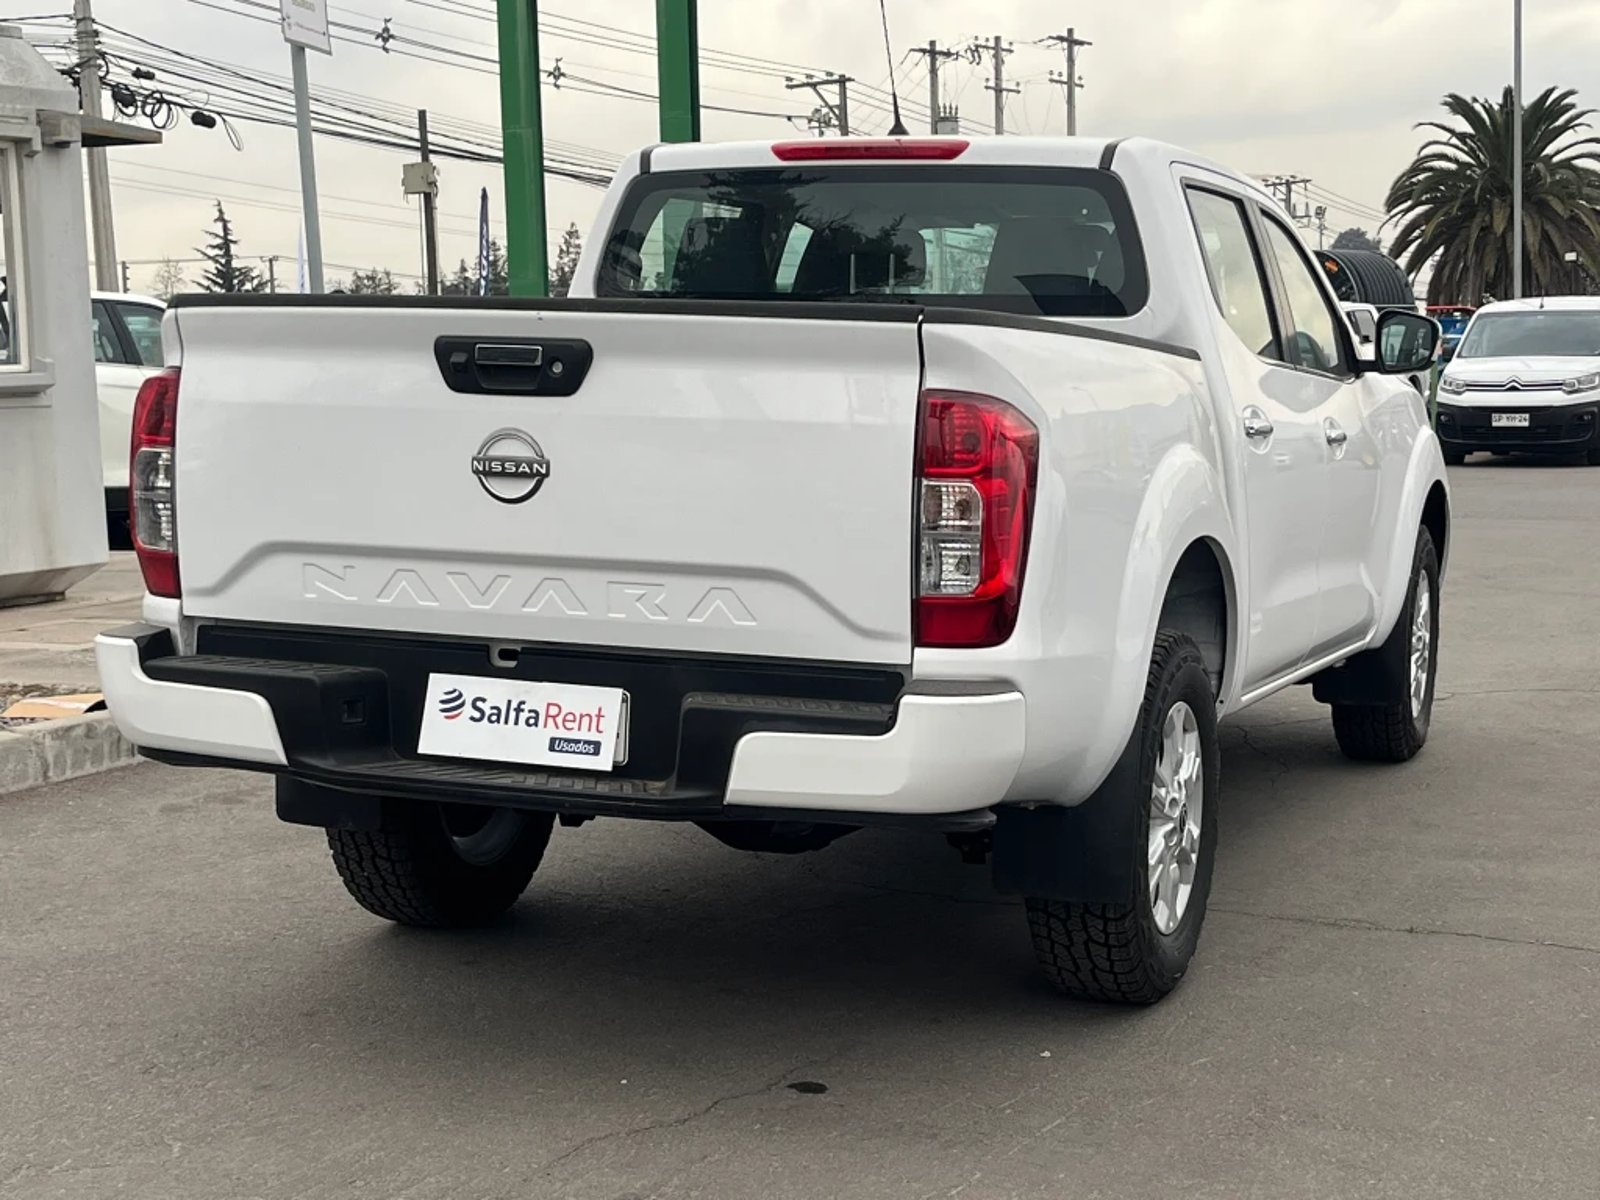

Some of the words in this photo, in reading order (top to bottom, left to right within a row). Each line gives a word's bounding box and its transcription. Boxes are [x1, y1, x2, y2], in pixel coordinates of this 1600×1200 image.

[472, 460, 547, 474] NISSAN
[303, 563, 758, 626] NAVARA
[553, 740, 595, 754] Usados
